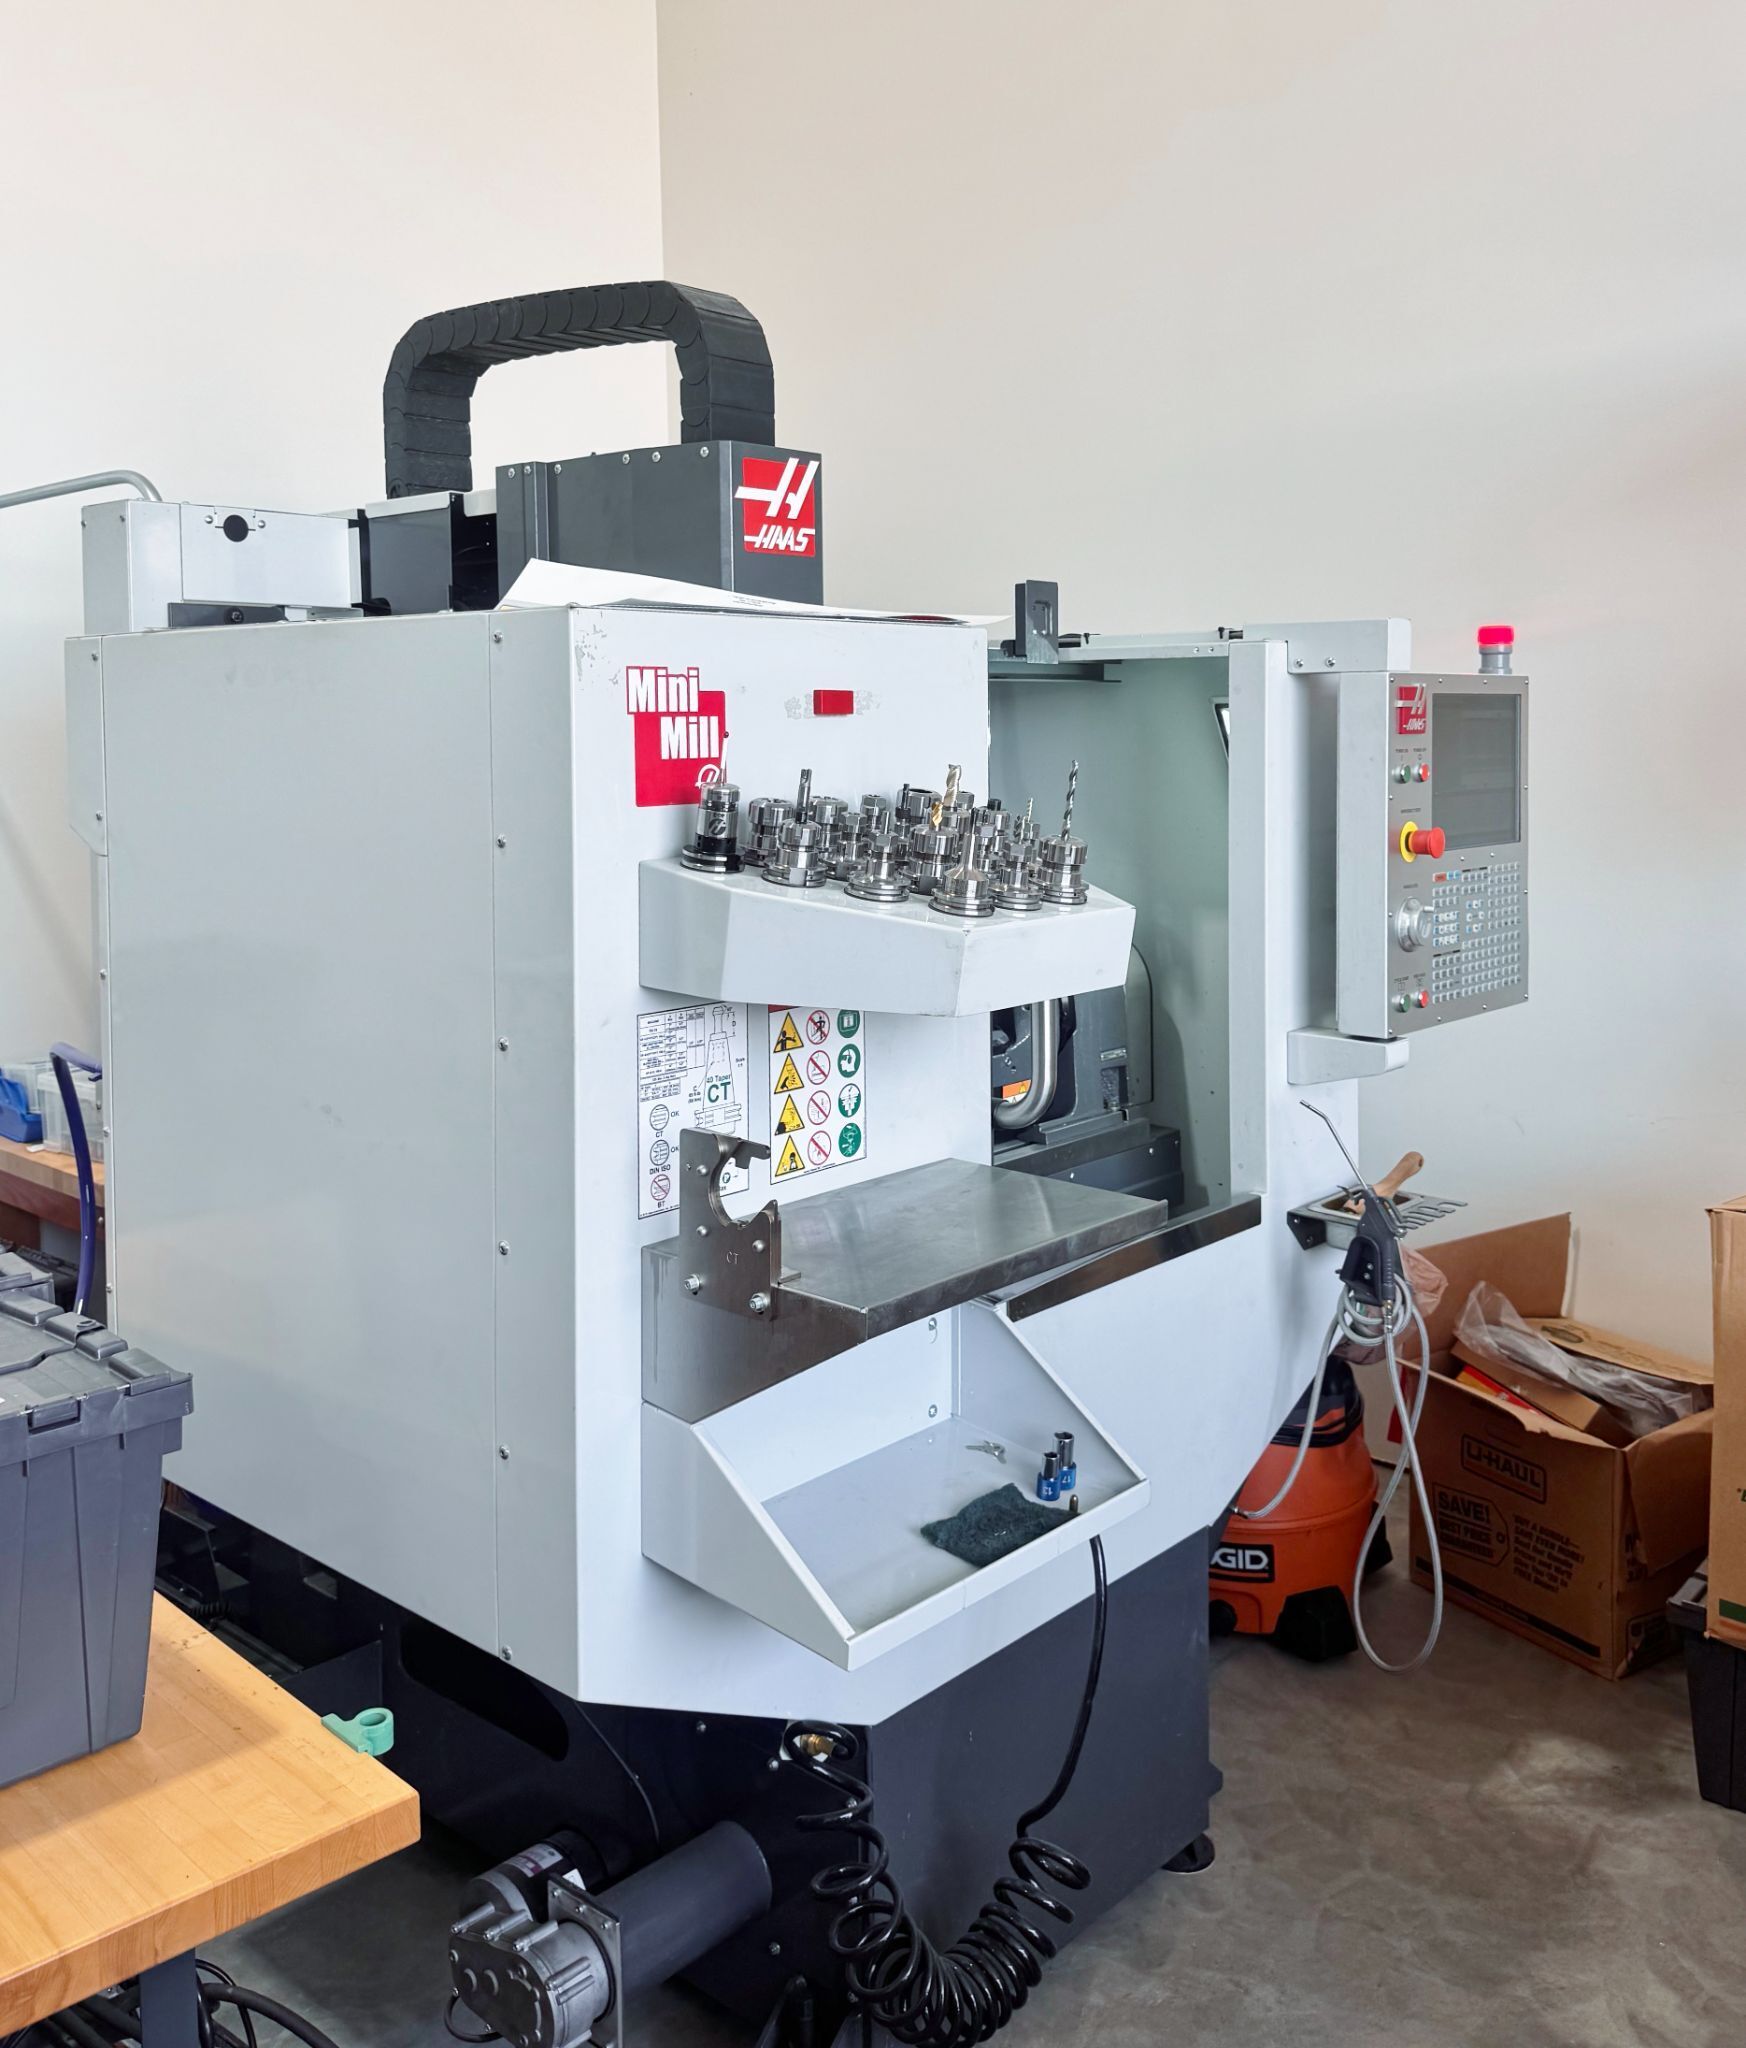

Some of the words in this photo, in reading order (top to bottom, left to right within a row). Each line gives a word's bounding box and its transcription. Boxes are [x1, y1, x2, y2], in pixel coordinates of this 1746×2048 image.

[744, 524, 816, 552] HAAS
[628, 668, 699, 713] Mini
[660, 716, 719, 760] Mill
[708, 1081, 731, 1103] CT
[715, 1074, 731, 1082] Taper
[649, 1167, 660, 1175] DIN
[726, 1251, 739, 1265] CT
[1466, 1441, 1541, 1488] U-HAUL
[1439, 1491, 1491, 1524] SAVE!
